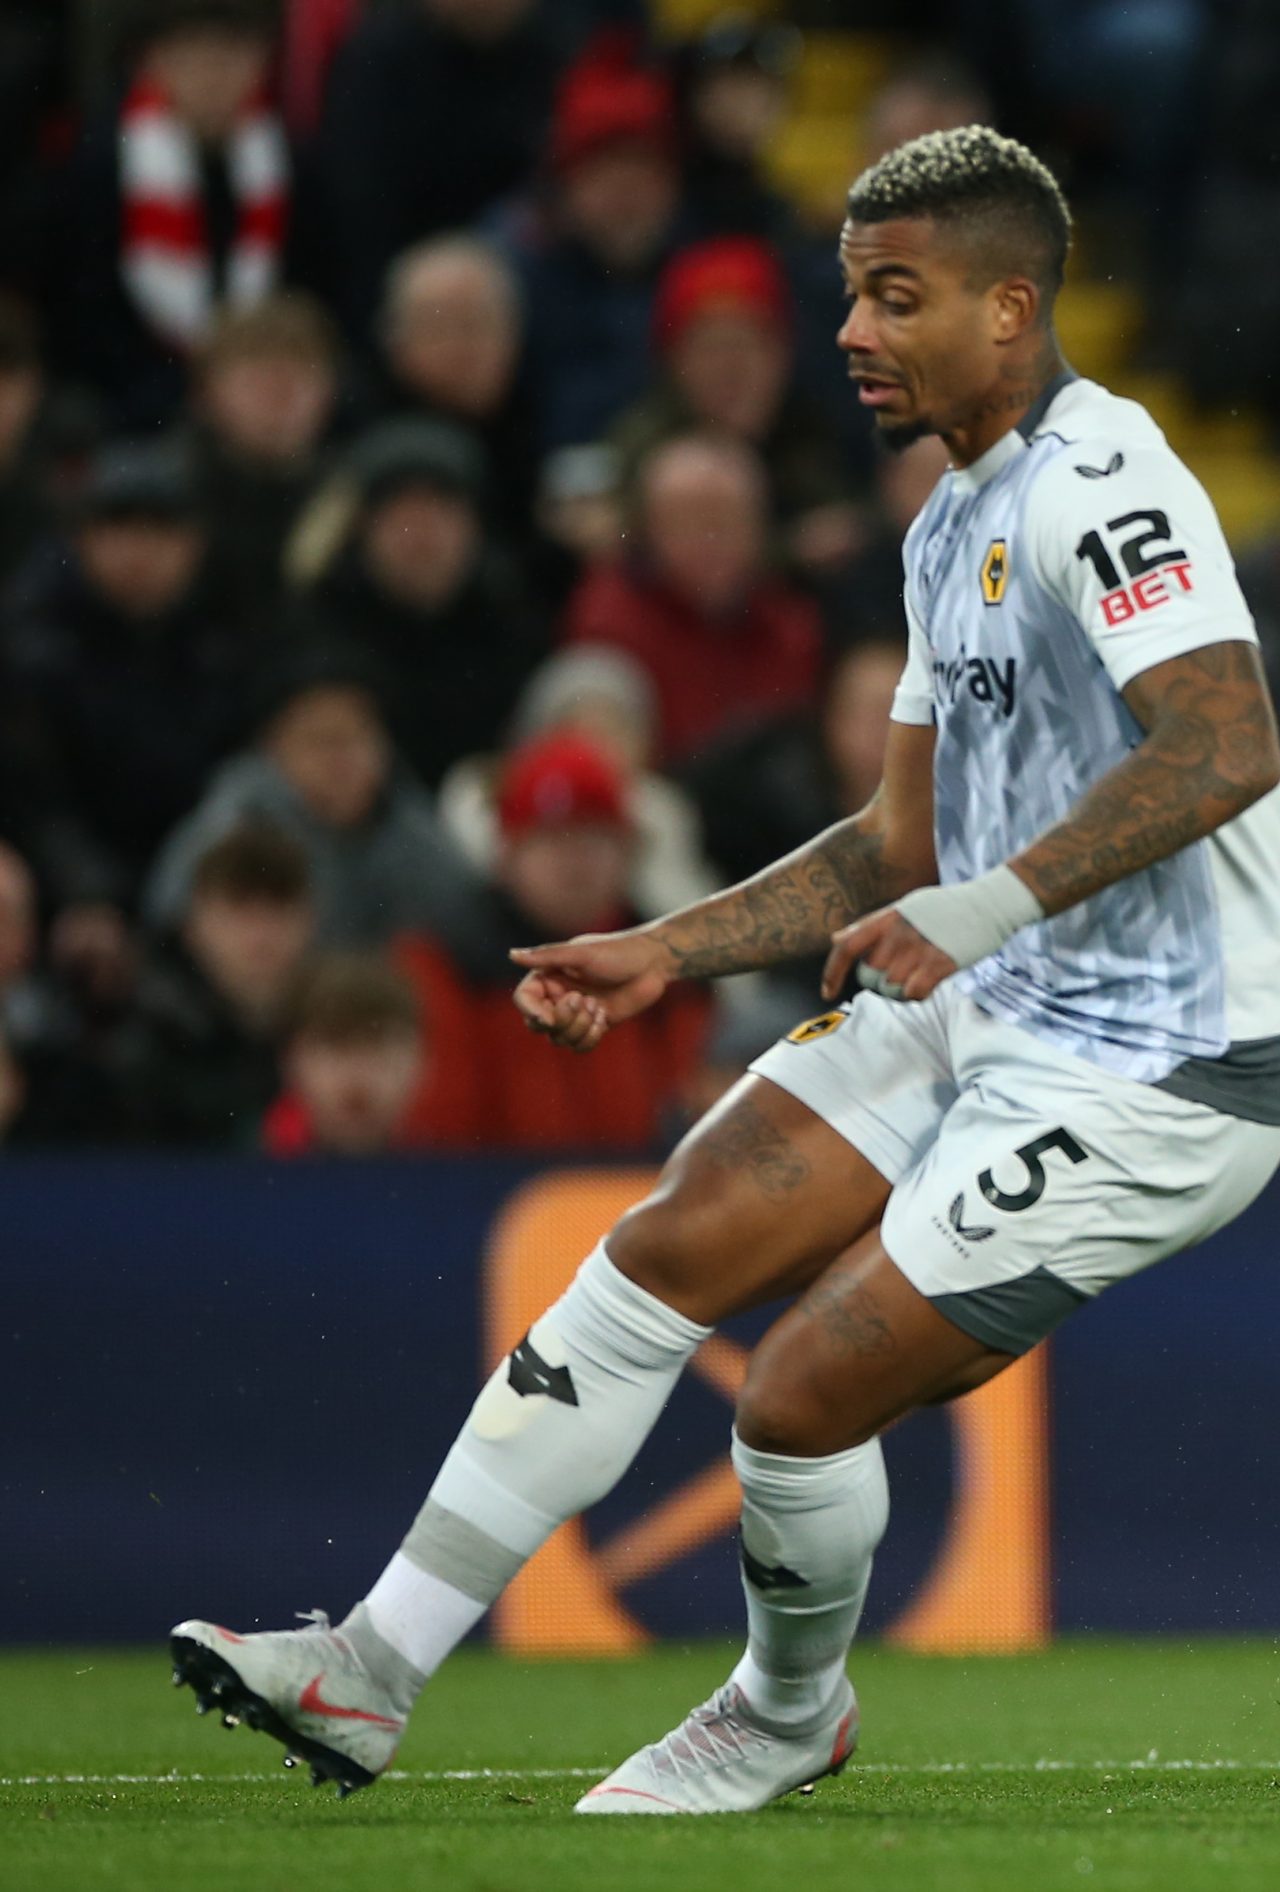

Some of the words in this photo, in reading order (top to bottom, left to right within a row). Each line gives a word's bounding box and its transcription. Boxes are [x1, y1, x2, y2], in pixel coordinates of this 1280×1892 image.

[1076, 509, 1187, 591] 12
[1099, 563, 1194, 626] BET
[977, 1127, 1088, 1212] 5
